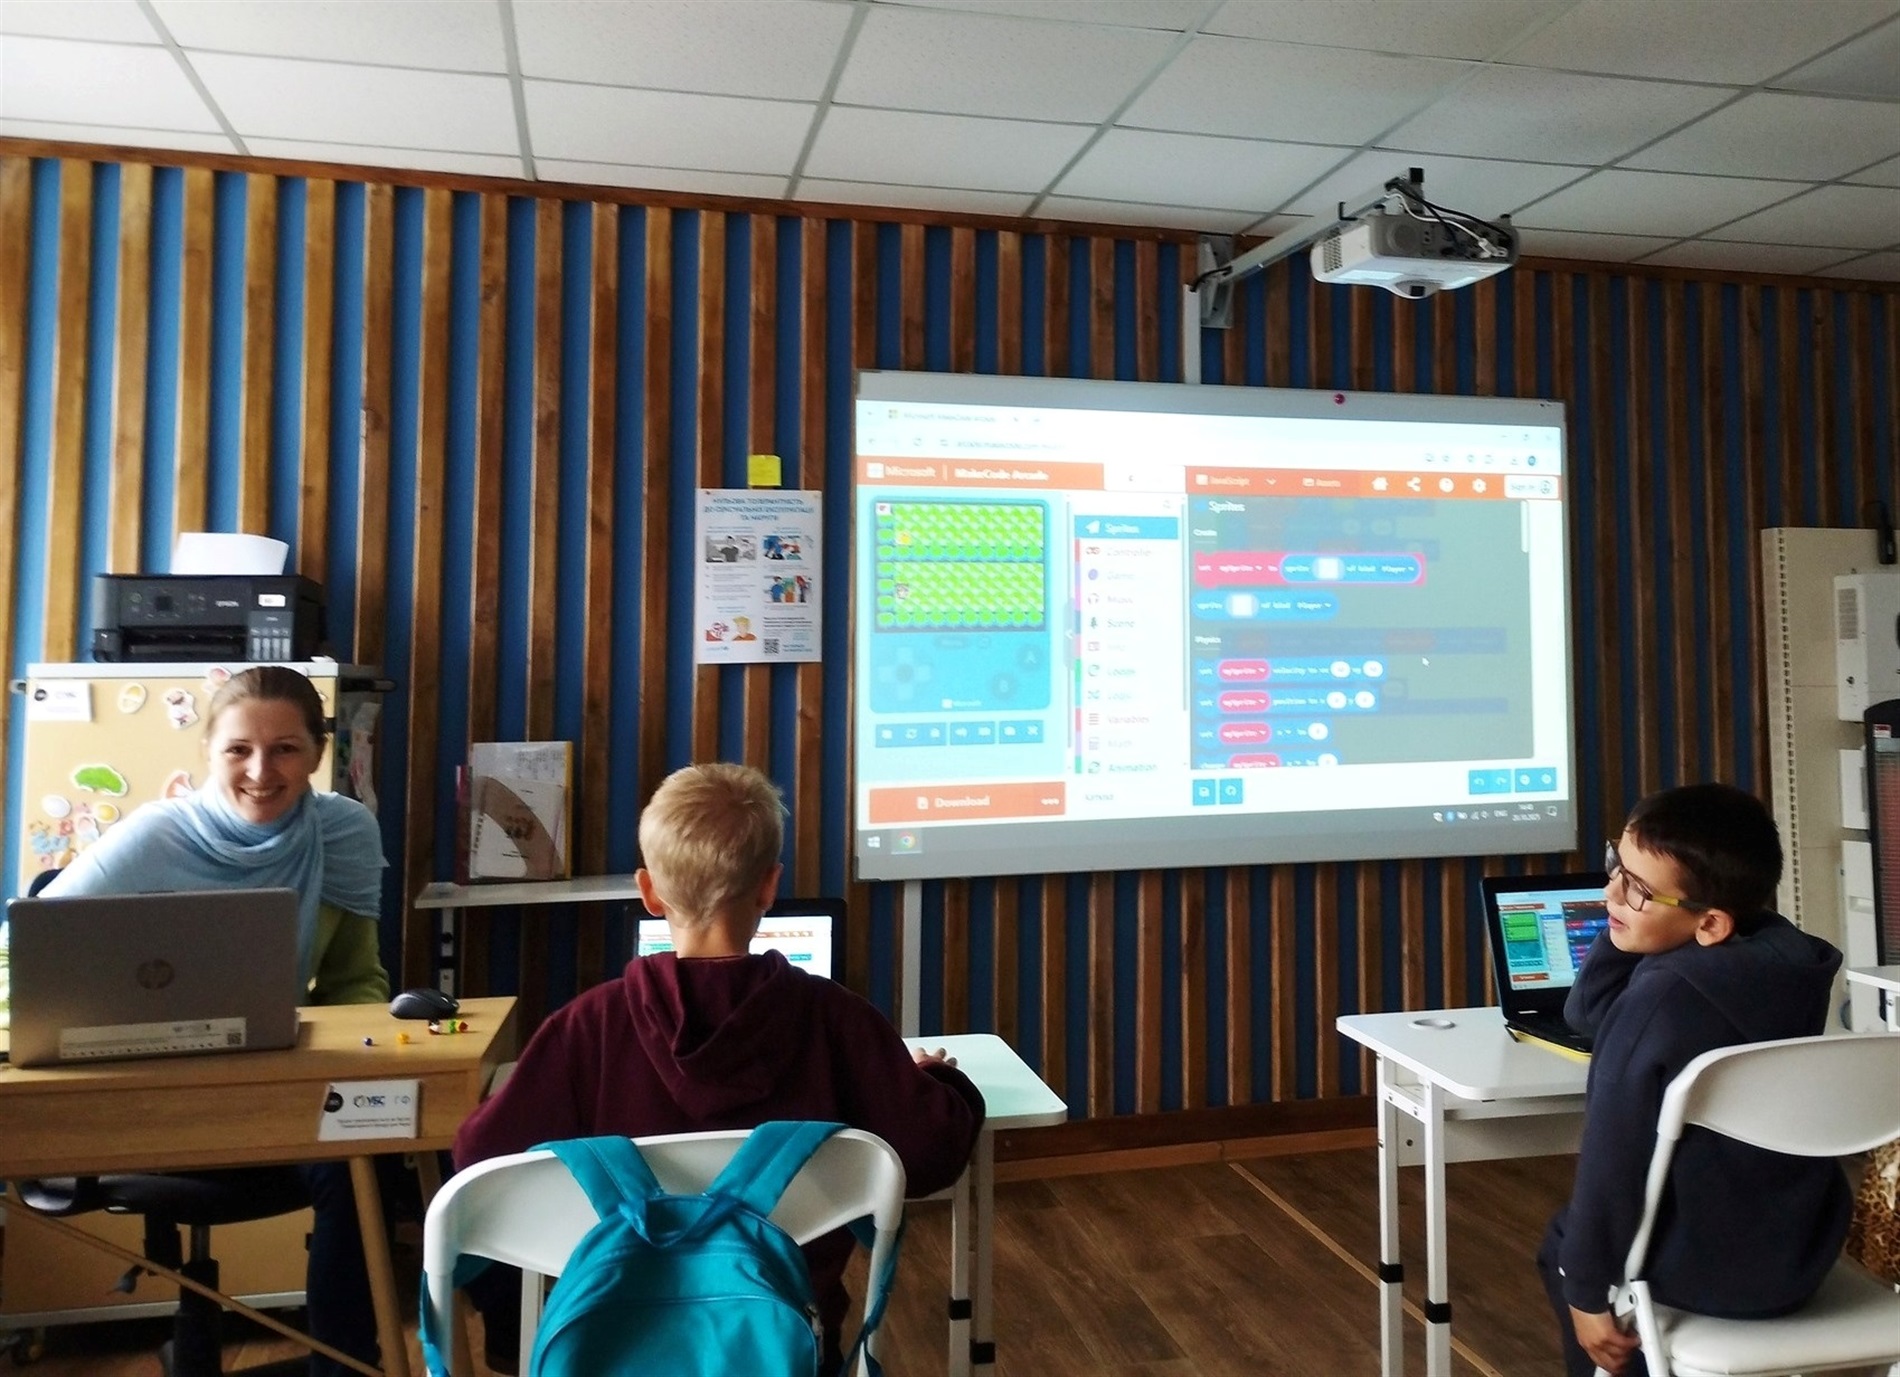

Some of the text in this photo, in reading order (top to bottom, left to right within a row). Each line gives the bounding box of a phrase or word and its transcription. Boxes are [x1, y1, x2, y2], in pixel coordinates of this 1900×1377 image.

[885, 465, 1050, 481] Microsoft MakeCode Arcade
[1208, 500, 1246, 514] Sprites
[1104, 523, 1140, 535] Sprites
[934, 795, 990, 809] Download
